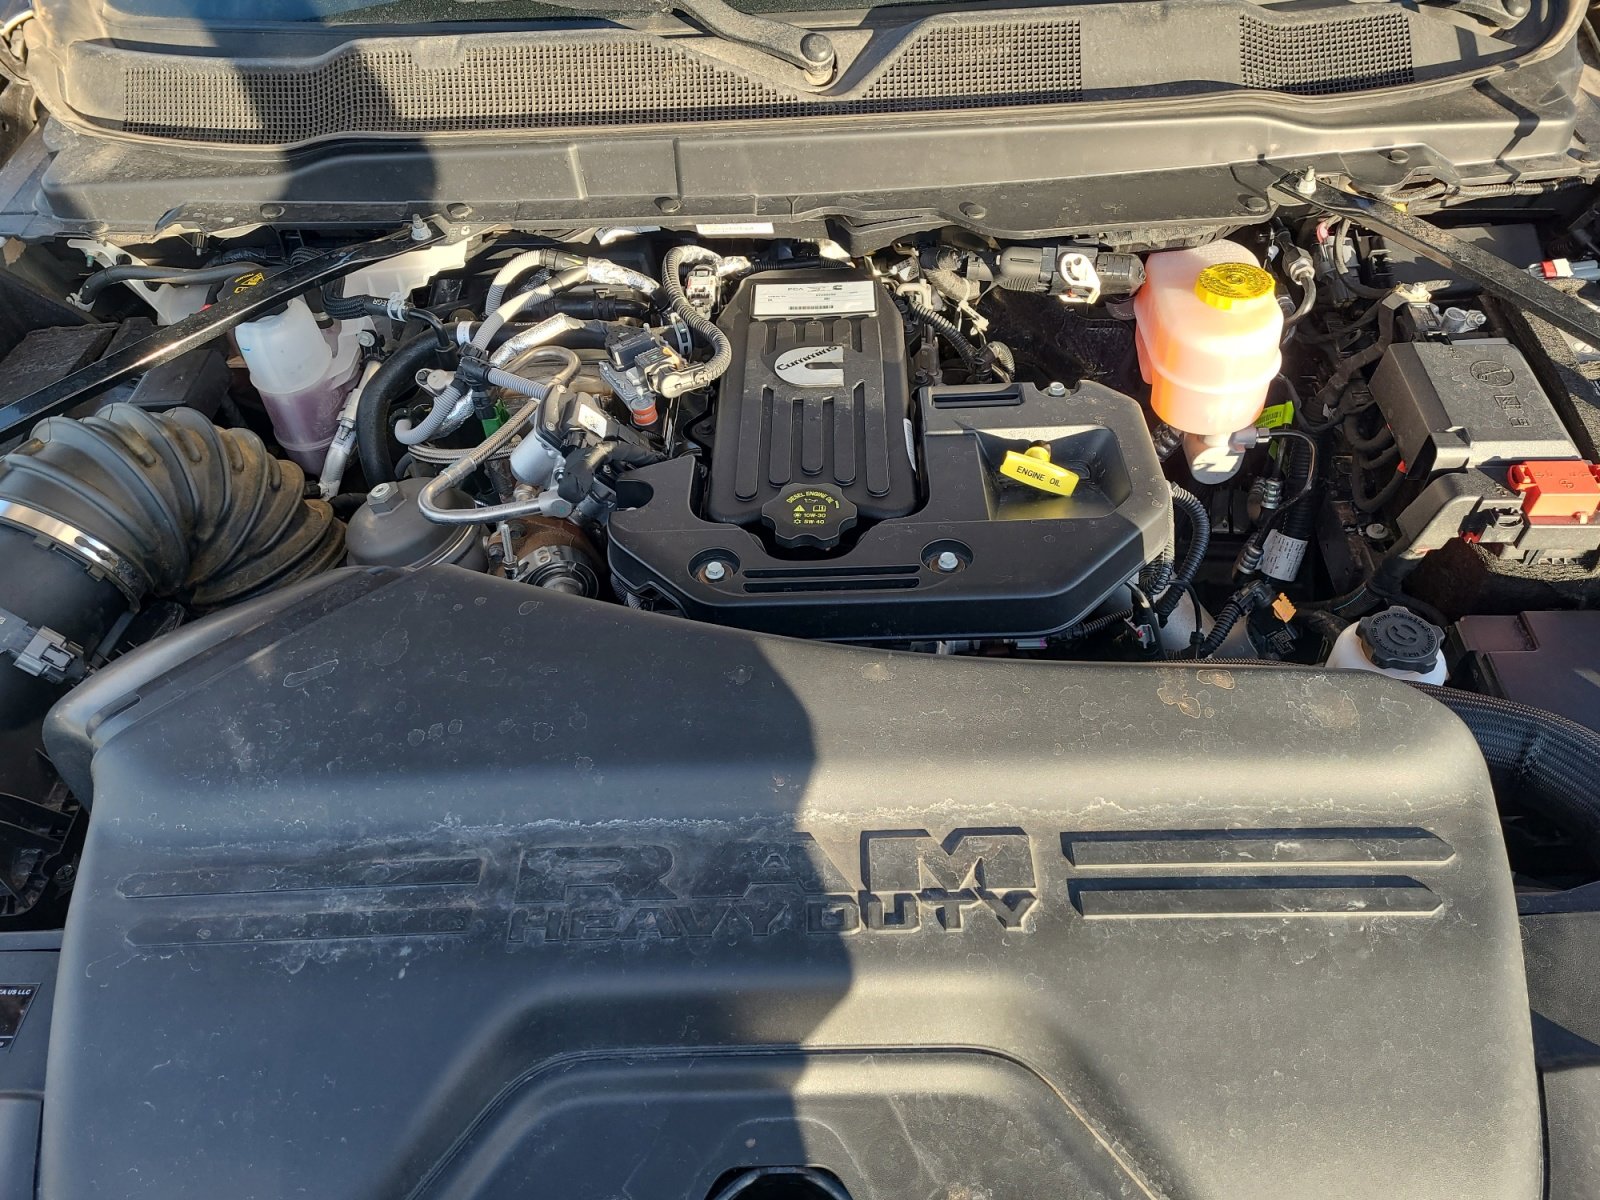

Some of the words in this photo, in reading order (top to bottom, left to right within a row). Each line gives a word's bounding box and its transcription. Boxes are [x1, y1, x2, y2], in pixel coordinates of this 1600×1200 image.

[776, 346, 838, 370] Cummins
[1016, 465, 1046, 482] ENGINE
[1049, 477, 1060, 487] OIL
[786, 492, 806, 504] DIESEL
[805, 491, 829, 499] ENGINE
[825, 496, 835, 504] OIL
[513, 828, 1038, 905] RAM
[506, 903, 790, 943] HEAVY
[802, 888, 1038, 935] DUTY
